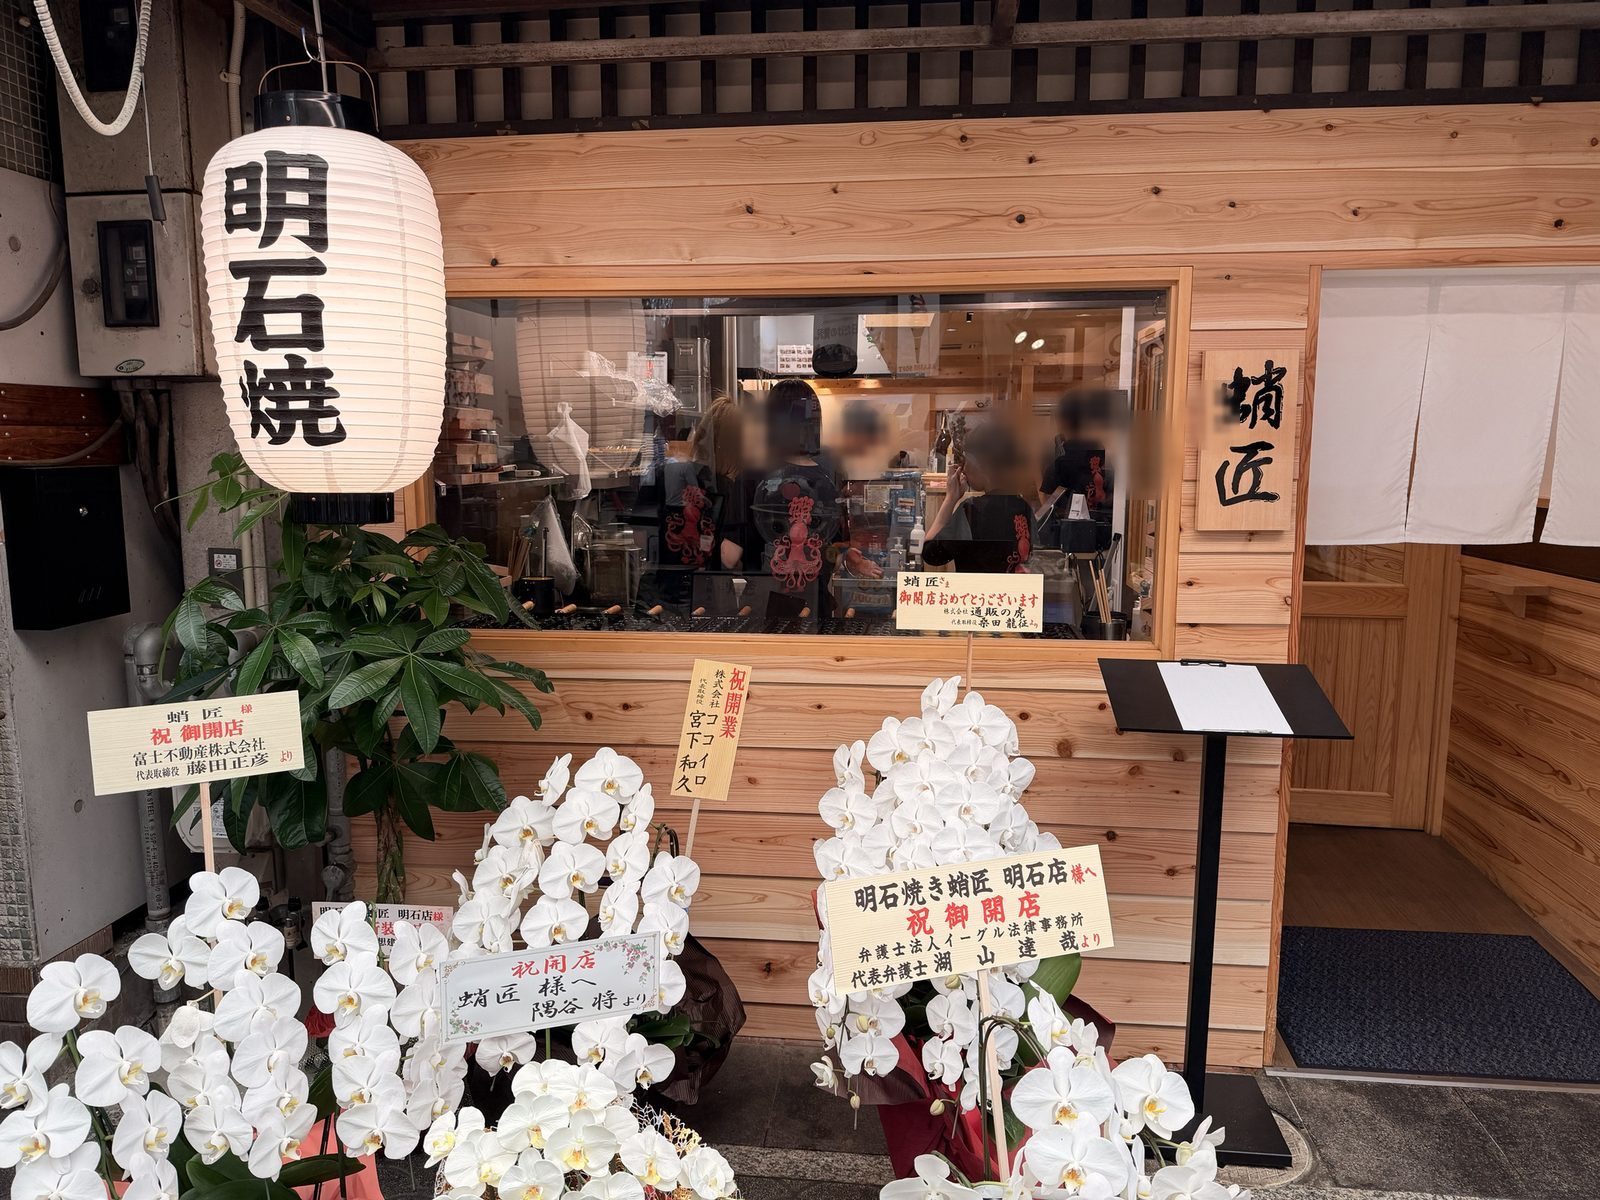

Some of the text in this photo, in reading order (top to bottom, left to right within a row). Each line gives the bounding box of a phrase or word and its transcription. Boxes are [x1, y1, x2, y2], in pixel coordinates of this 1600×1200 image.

[225, 150, 346, 446] 明石焼
[1215, 360, 1288, 507] 蛸匠
[899, 589, 1039, 608] 御開店おめでとうございます
[970, 606, 1026, 619] 通販の虎
[241, 704, 252, 715] 様
[719, 667, 747, 739] 祝開業
[133, 737, 266, 767] 富士不動産株式会社
[675, 709, 706, 793] 宮下和久
[136, 767, 180, 782] 代表取締役
[186, 752, 269, 776] 藤田正彦
[854, 868, 994, 913] 明石焼き蛸匠
[858, 912, 1084, 964] 弁護士法人イーグル法律事務所
[511, 950, 596, 979] 祝開店
[851, 960, 928, 989] 代表弁護士
